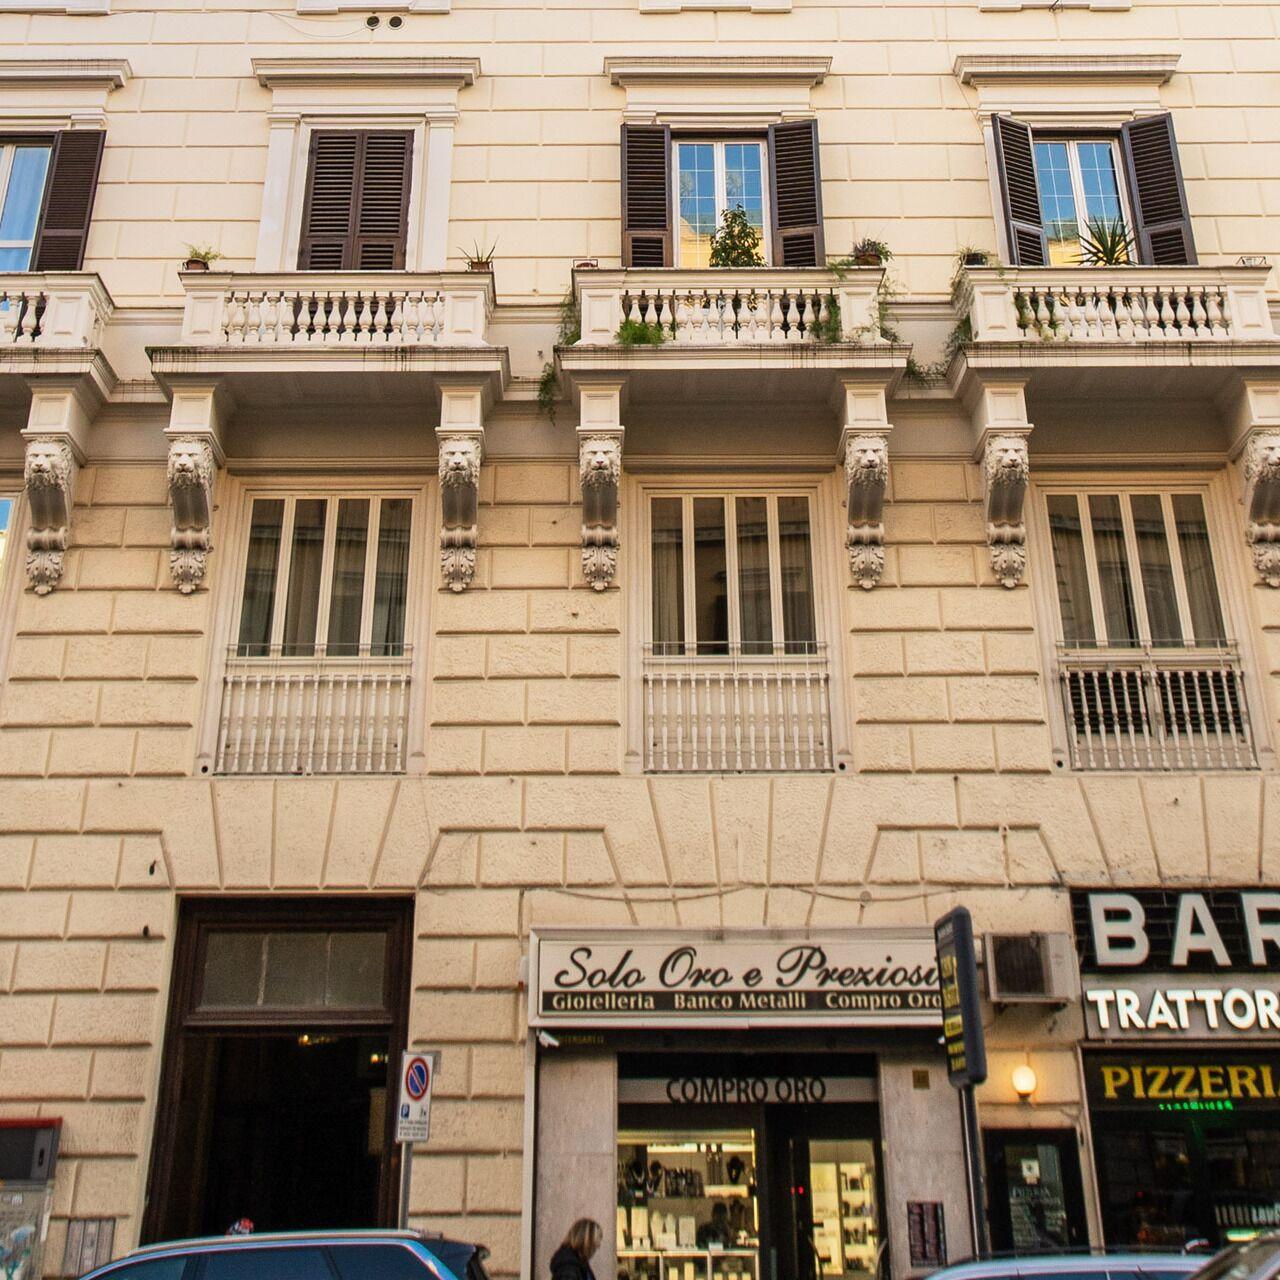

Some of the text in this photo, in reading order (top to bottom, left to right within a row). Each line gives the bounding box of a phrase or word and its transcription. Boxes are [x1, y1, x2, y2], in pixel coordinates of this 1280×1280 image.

[554, 947, 645, 988] Solo
[659, 946, 733, 988] Oro
[742, 968, 763, 987] e
[776, 945, 940, 988] Preziosi
[552, 991, 941, 1010] Gioielleria Banco Metalli Compro Oro
[666, 1076, 826, 1104] COMPRO ORO
